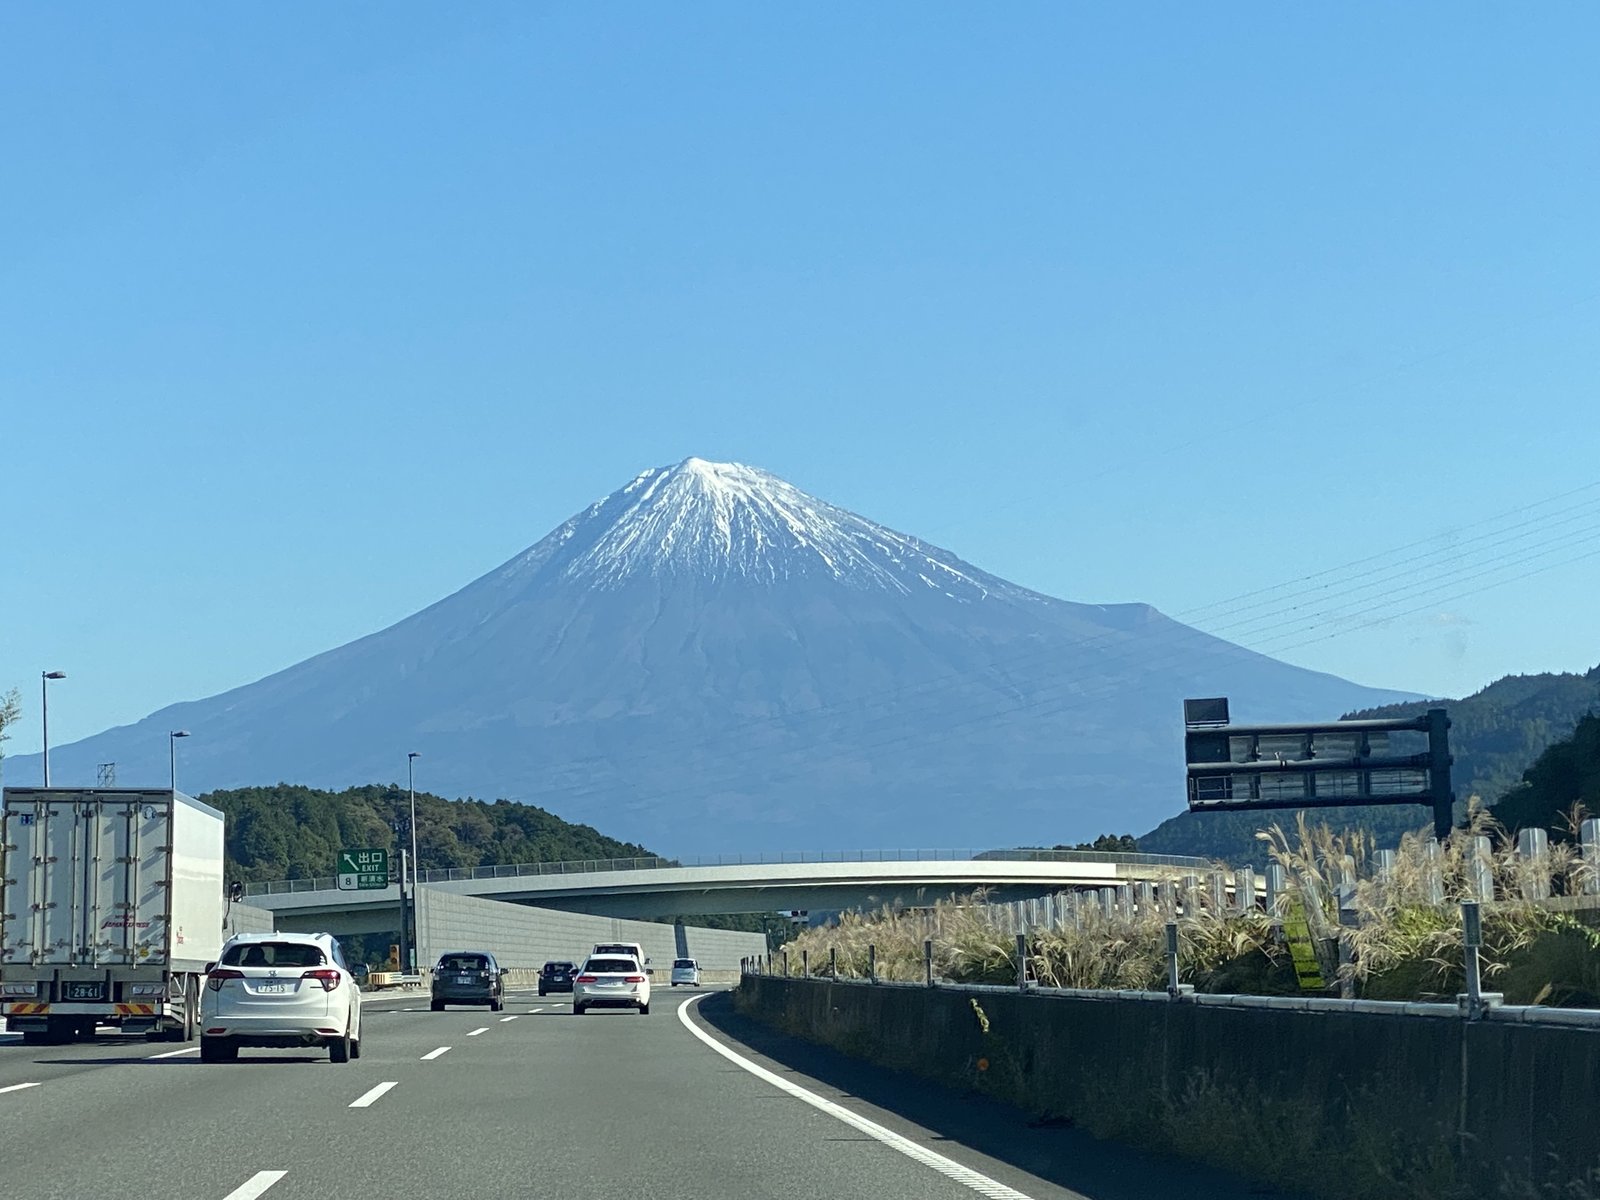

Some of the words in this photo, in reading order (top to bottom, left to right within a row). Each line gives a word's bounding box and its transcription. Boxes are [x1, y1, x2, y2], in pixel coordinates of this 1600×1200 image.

[358, 852, 382, 863] 出口
[362, 864, 379, 872] EXIT
[74, 987, 98, 997] 28-61
